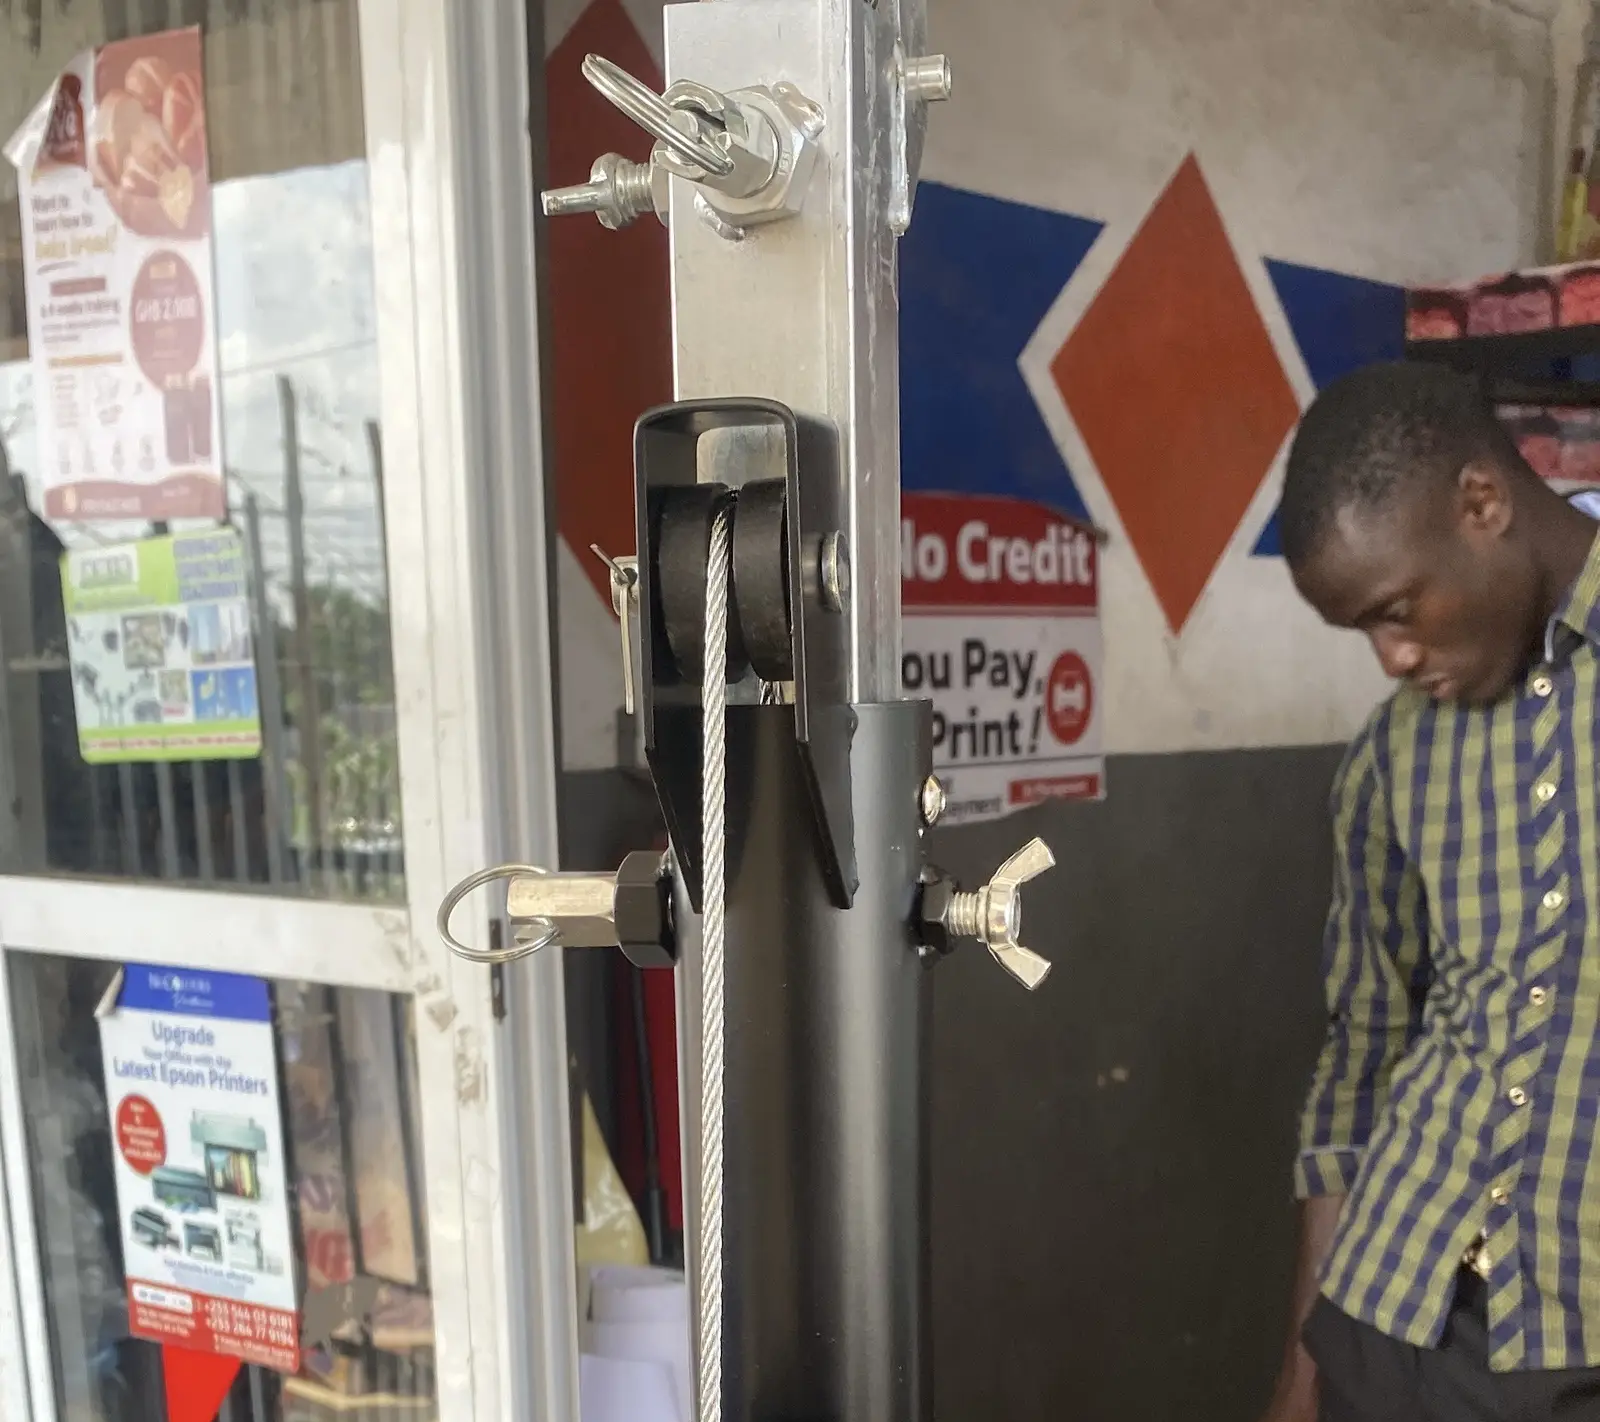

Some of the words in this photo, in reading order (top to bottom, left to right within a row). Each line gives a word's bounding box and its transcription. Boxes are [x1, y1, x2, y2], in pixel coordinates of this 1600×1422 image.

[956, 520, 1092, 585] Credit
[902, 652, 950, 689] ou
[151, 1019, 215, 1047] Upgrade
[113, 1055, 157, 1081] Latest
[160, 1062, 206, 1089] Epson
[208, 1066, 268, 1096] Printers
